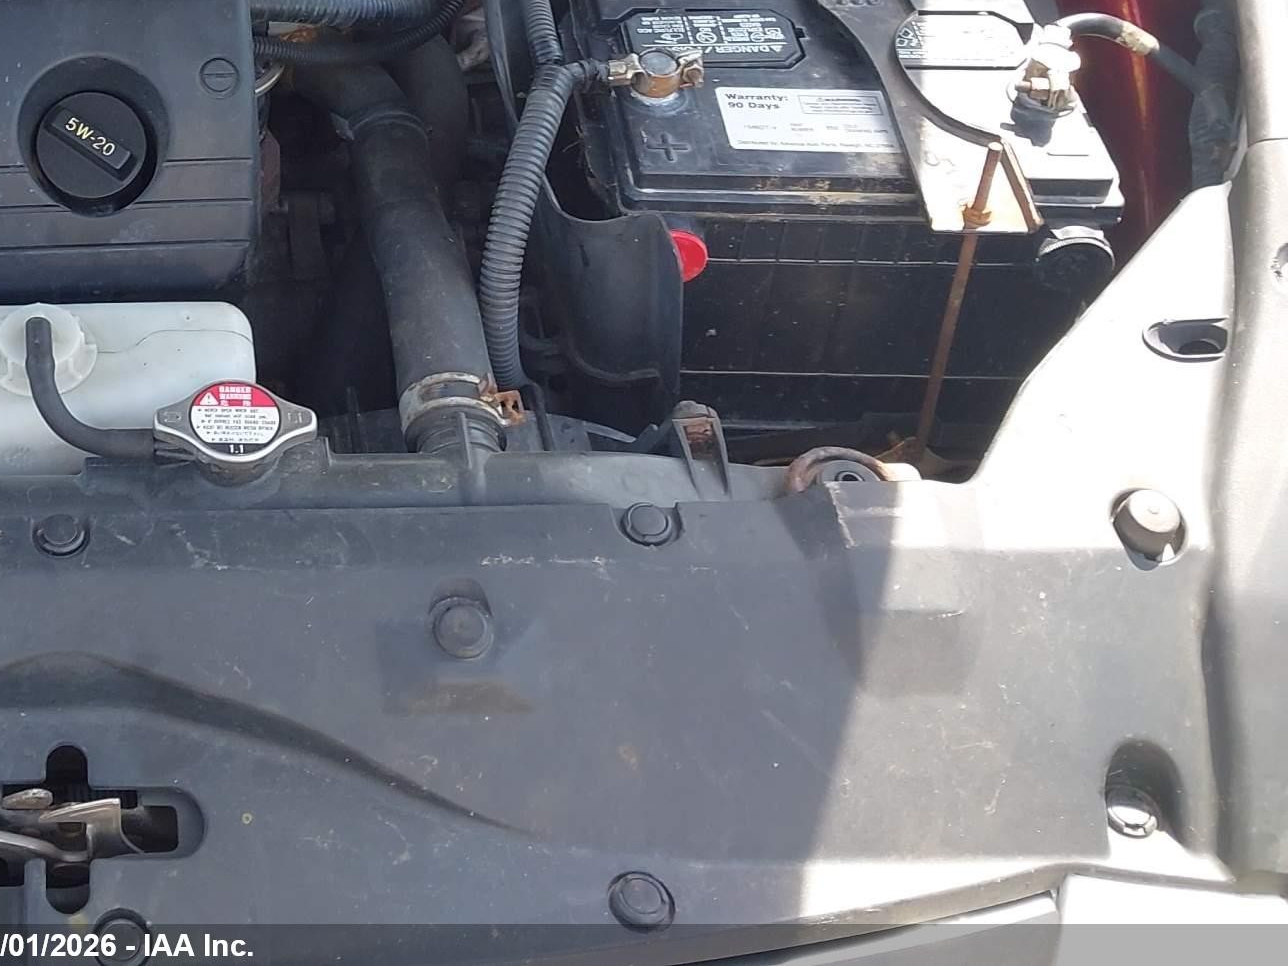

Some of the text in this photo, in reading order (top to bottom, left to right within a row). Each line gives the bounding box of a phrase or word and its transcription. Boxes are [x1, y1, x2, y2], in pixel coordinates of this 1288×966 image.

[715, 45, 770, 53] DANGER
[724, 93, 789, 101] Warranty:
[748, 101, 781, 110] Days
[65, 117, 116, 156] 5W-20
[229, 444, 244, 454] 1.1
